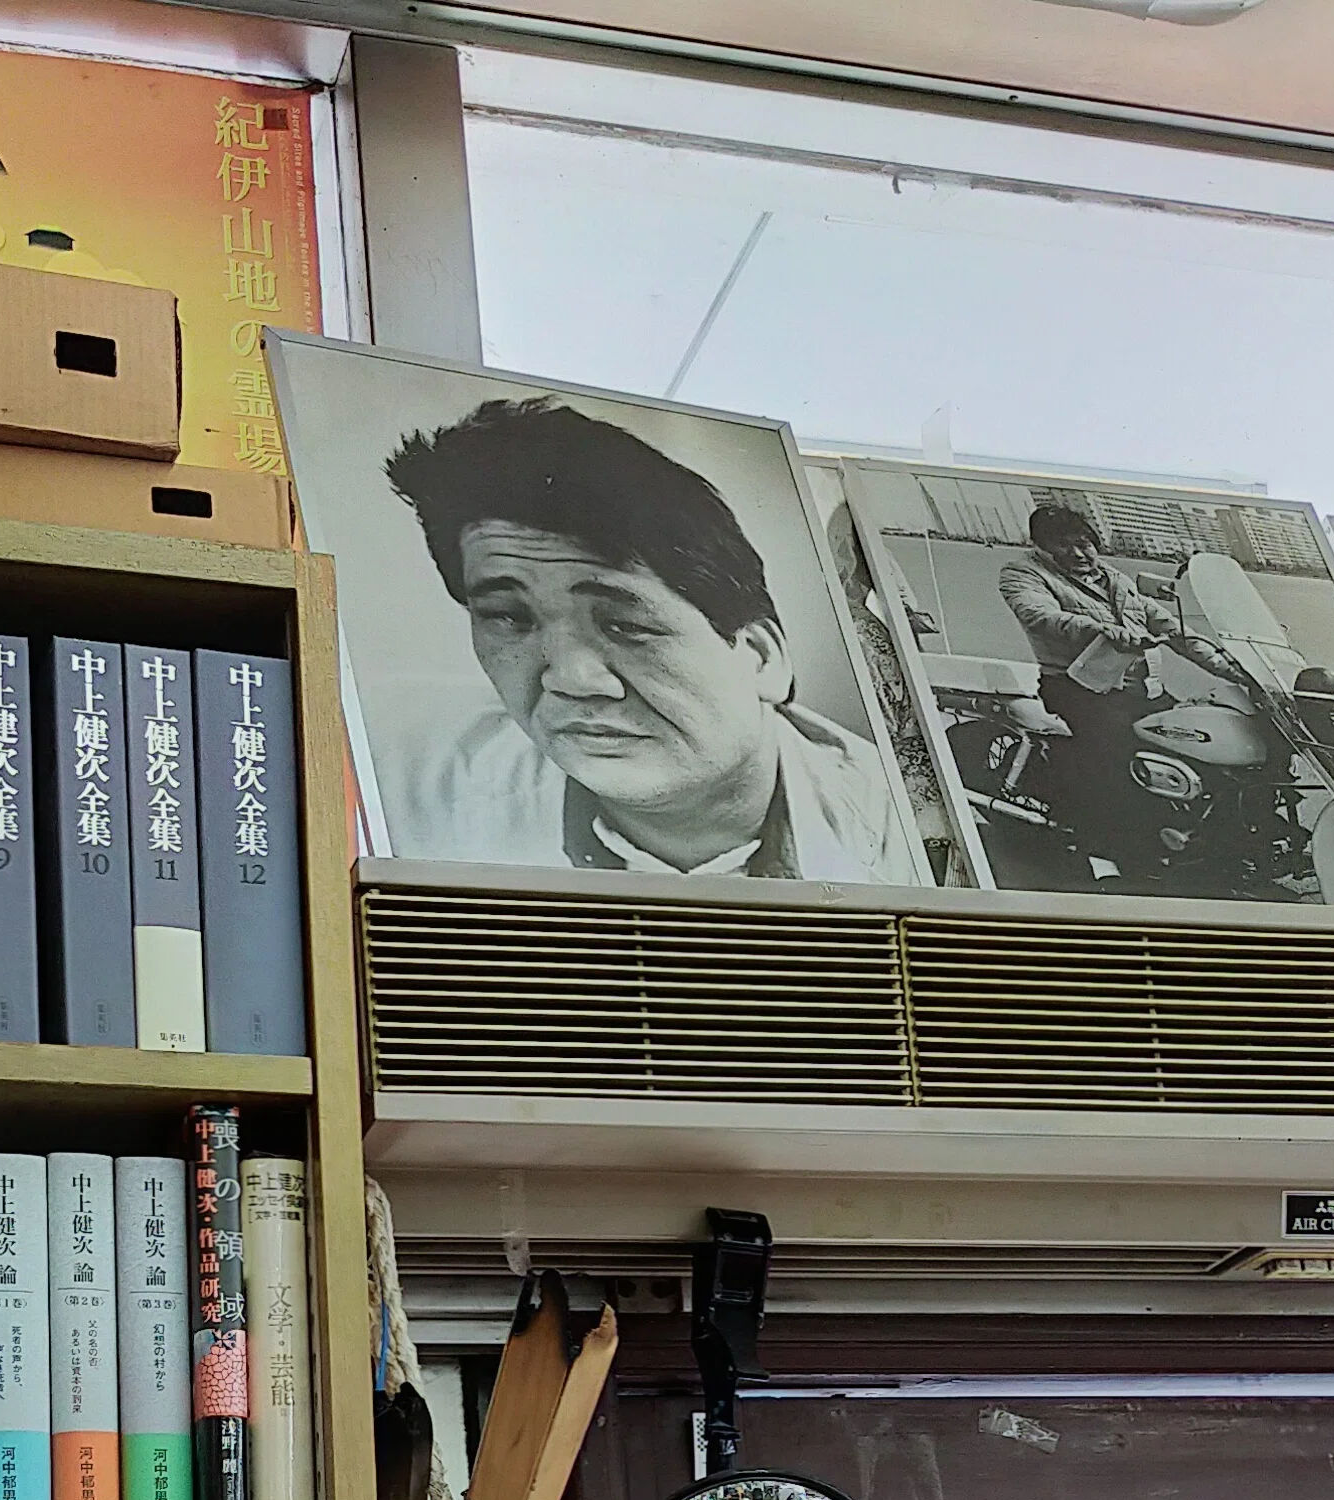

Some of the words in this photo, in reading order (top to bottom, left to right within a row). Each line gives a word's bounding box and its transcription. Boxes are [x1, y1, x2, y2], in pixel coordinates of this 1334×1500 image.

[214, 96, 289, 476] 紀伊山地の霊場
[70, 648, 113, 849] 中上健次全集
[141, 656, 184, 854] 中上健次全集
[228, 663, 270, 858] 中上健次全集
[79, 850, 111, 877] 10
[153, 858, 180, 883] 11
[237, 861, 267, 887] 12
[1292, 1217, 1319, 1231] AIR
